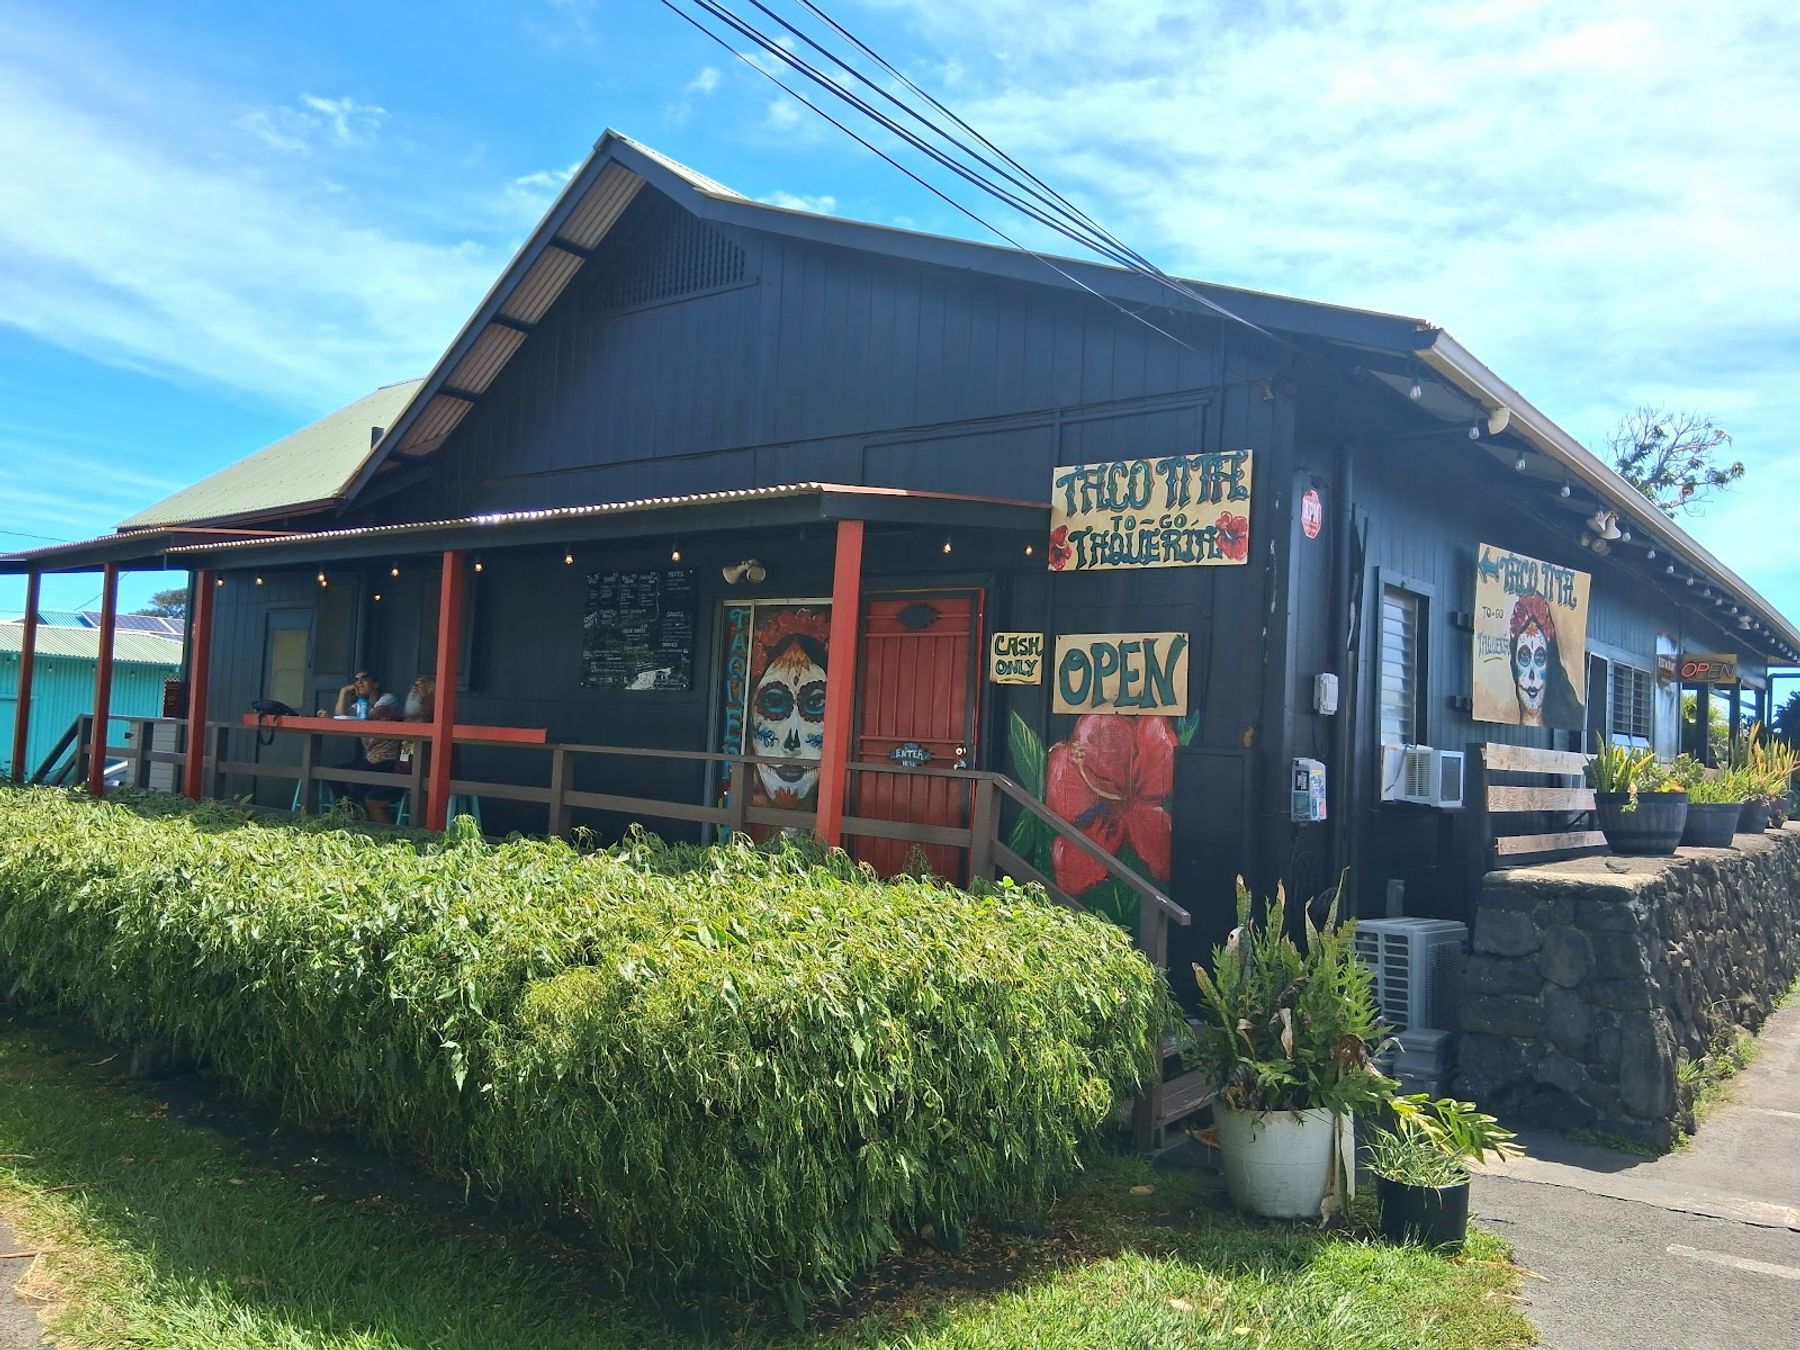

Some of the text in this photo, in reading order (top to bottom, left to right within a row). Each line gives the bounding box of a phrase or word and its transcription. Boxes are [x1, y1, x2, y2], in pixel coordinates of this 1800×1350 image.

[1055, 460, 1155, 519] TACO
[1109, 513, 1188, 531] TO-GO
[1499, 553, 1538, 597] TACO
[994, 635, 1045, 657] CASH
[995, 658, 1039, 676] ONLY
[1058, 634, 1188, 710] OPEN
[1681, 662, 1736, 678] OPEN
[895, 748, 924, 760] ENTER
